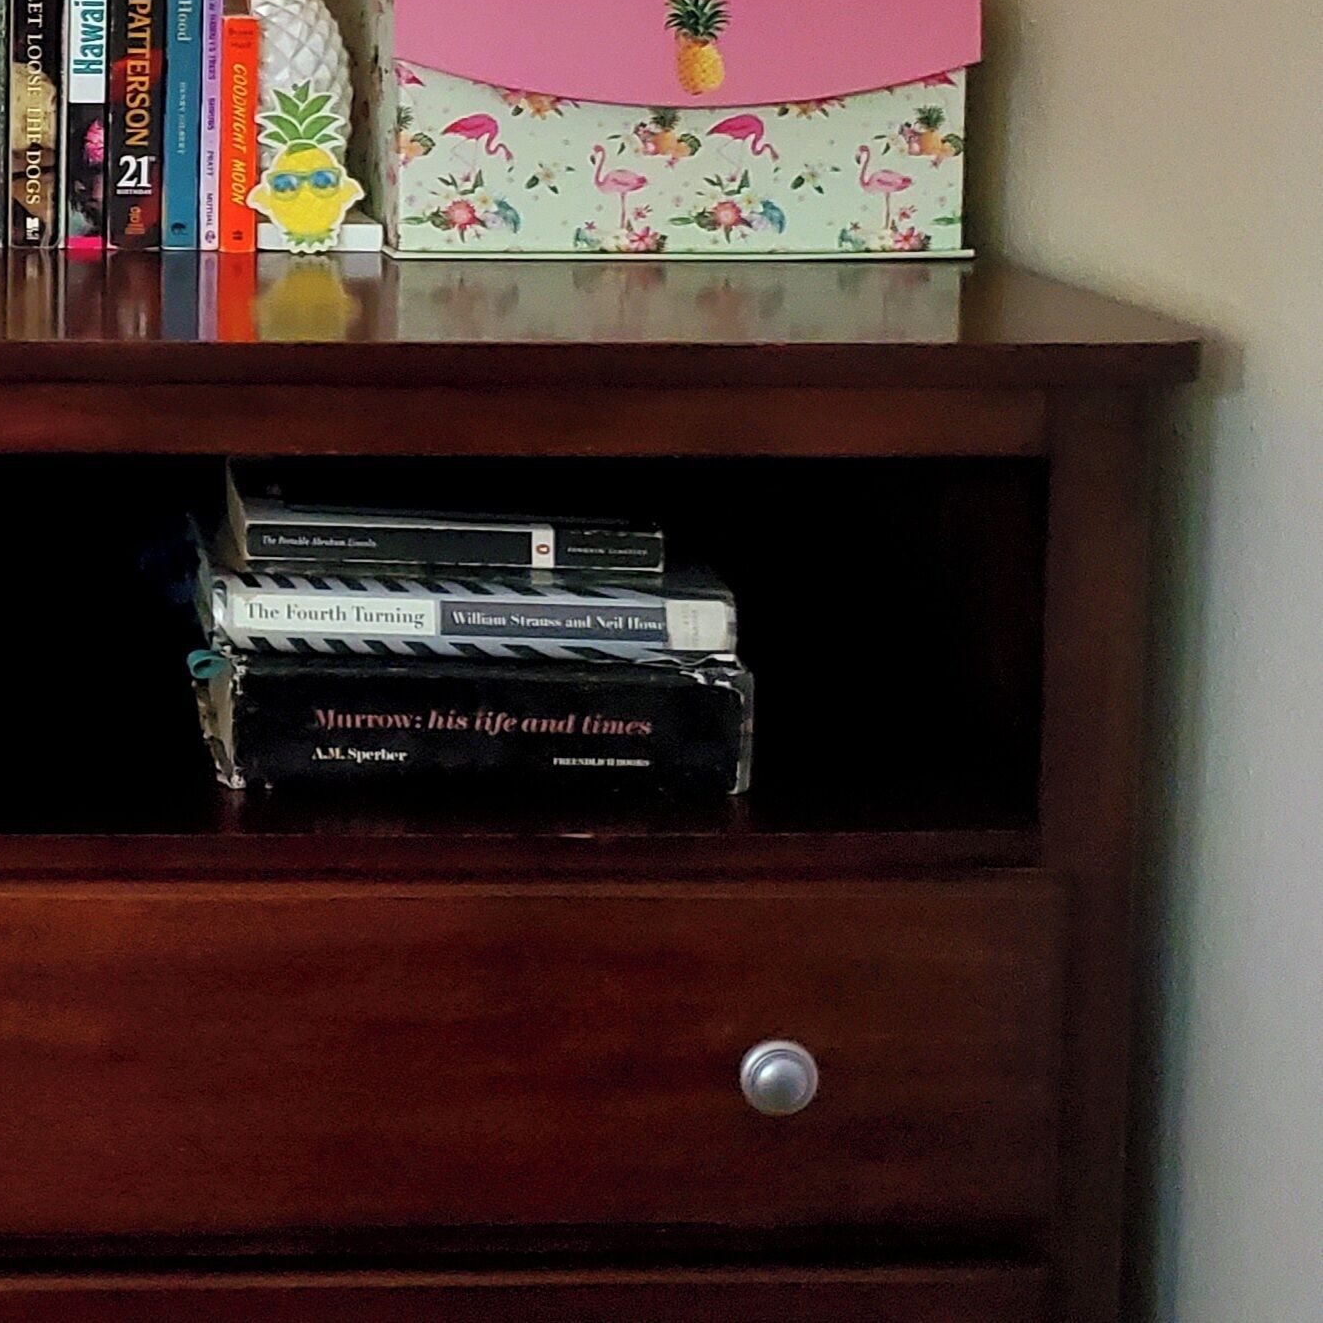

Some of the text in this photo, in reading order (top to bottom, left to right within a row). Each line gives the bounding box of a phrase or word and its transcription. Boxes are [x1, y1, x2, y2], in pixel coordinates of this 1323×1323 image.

[177, 0, 193, 41] Hood
[26, 34, 43, 96] LOOSE
[178, 82, 186, 112] HENRY
[232, 63, 248, 154] GOODNIGHT
[26, 107, 41, 144] THE
[25, 150, 41, 205] DOGS
[231, 159, 246, 206] MOON
[206, 192, 214, 226] MUTUAL
[262, 534, 276, 544] The
[245, 601, 426, 630] The Fourth Turning
[452, 610, 507, 627] William
[510, 614, 562, 629] Strauss
[564, 615, 592, 630] and
[596, 616, 623, 631] Neil
[313, 708, 653, 736] Murrow: his life and times
[312, 746, 408, 764] A.M. Sperber
